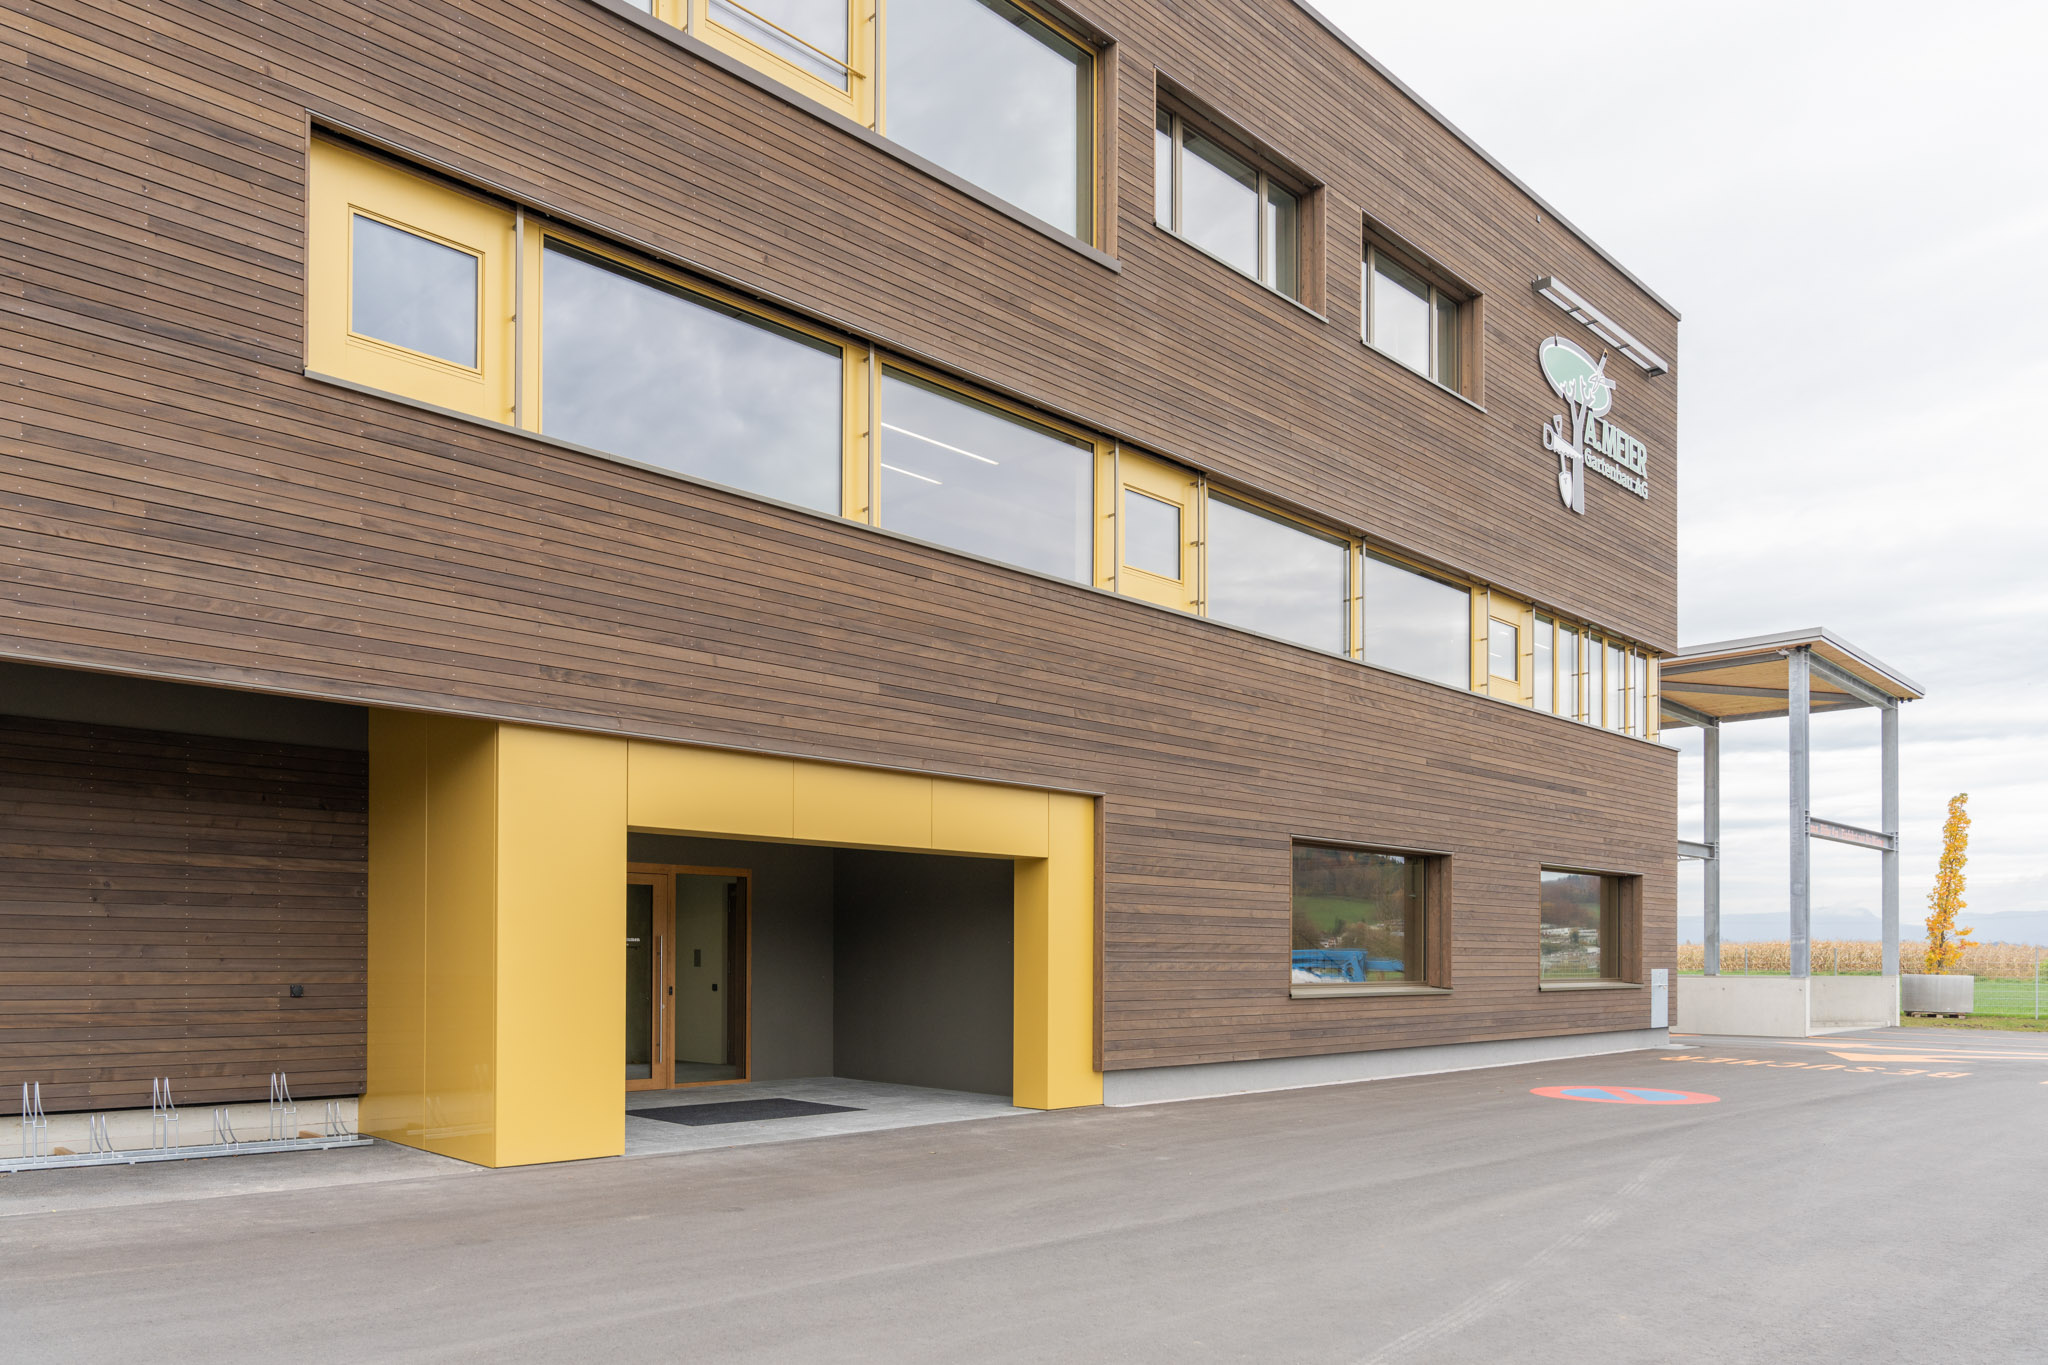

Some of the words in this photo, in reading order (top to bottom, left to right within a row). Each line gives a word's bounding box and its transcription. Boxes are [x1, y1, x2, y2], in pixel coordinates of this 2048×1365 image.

[1584, 447, 1635, 491] Gartenbau
[1635, 479, 1649, 499] AG
[1659, 1055, 1974, 1079] BESUCHER
